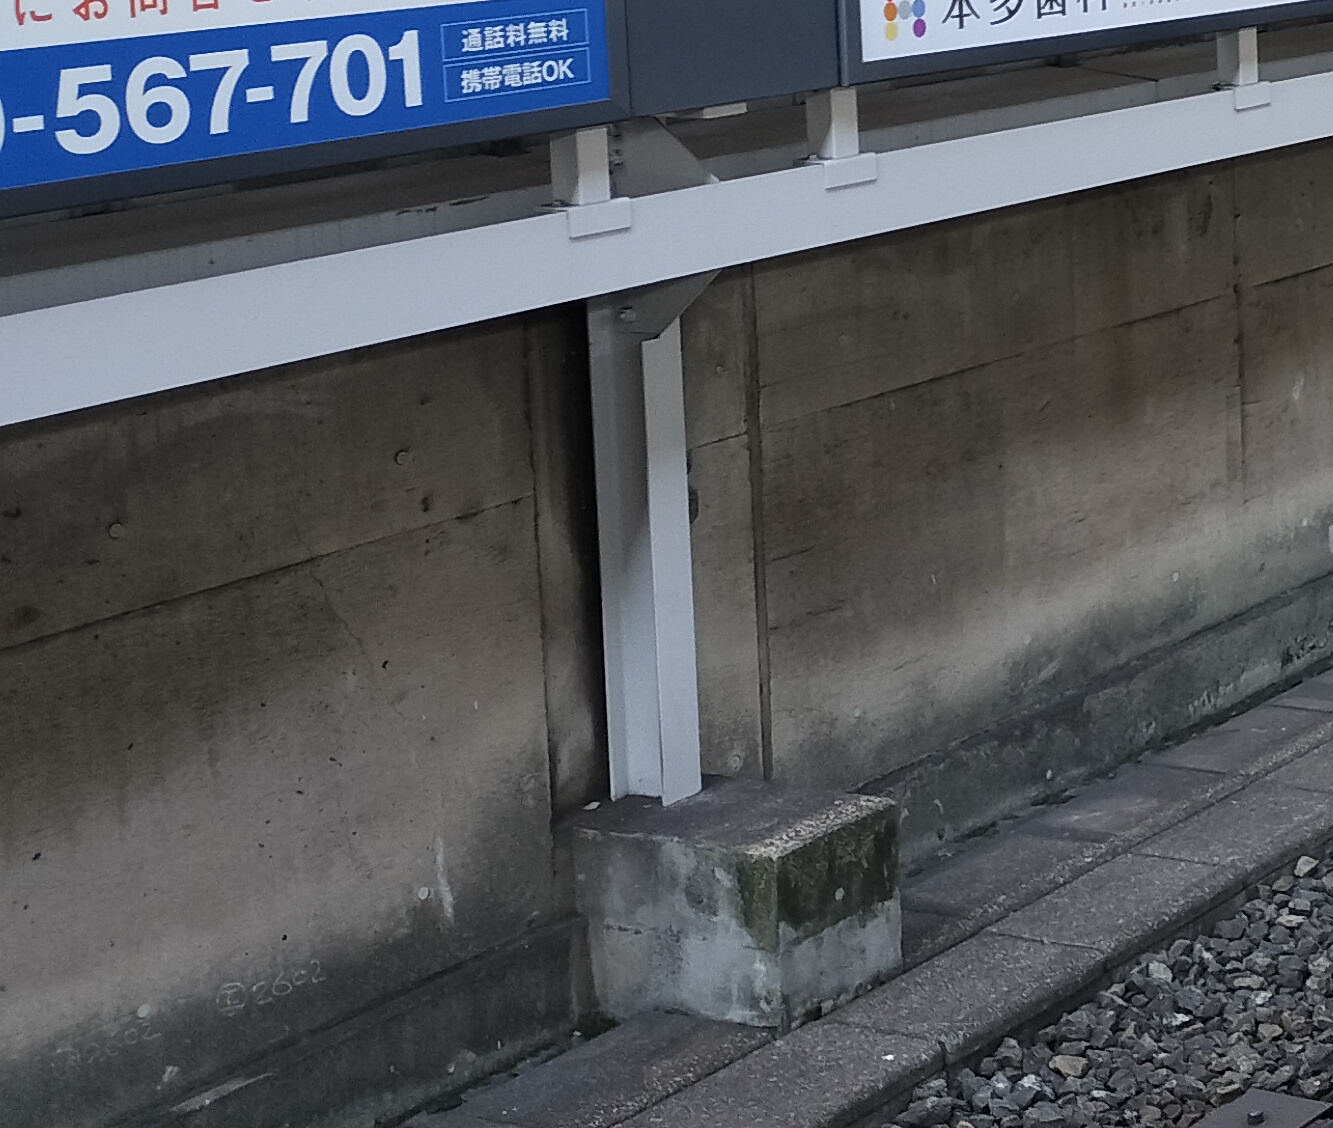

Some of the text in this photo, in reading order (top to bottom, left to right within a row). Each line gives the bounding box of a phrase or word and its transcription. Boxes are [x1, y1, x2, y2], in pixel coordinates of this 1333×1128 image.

[460, 18, 571, 53] 通話料無料
[0, 29, 424, 155] -567-701
[459, 57, 576, 94] 携帯電話OK
